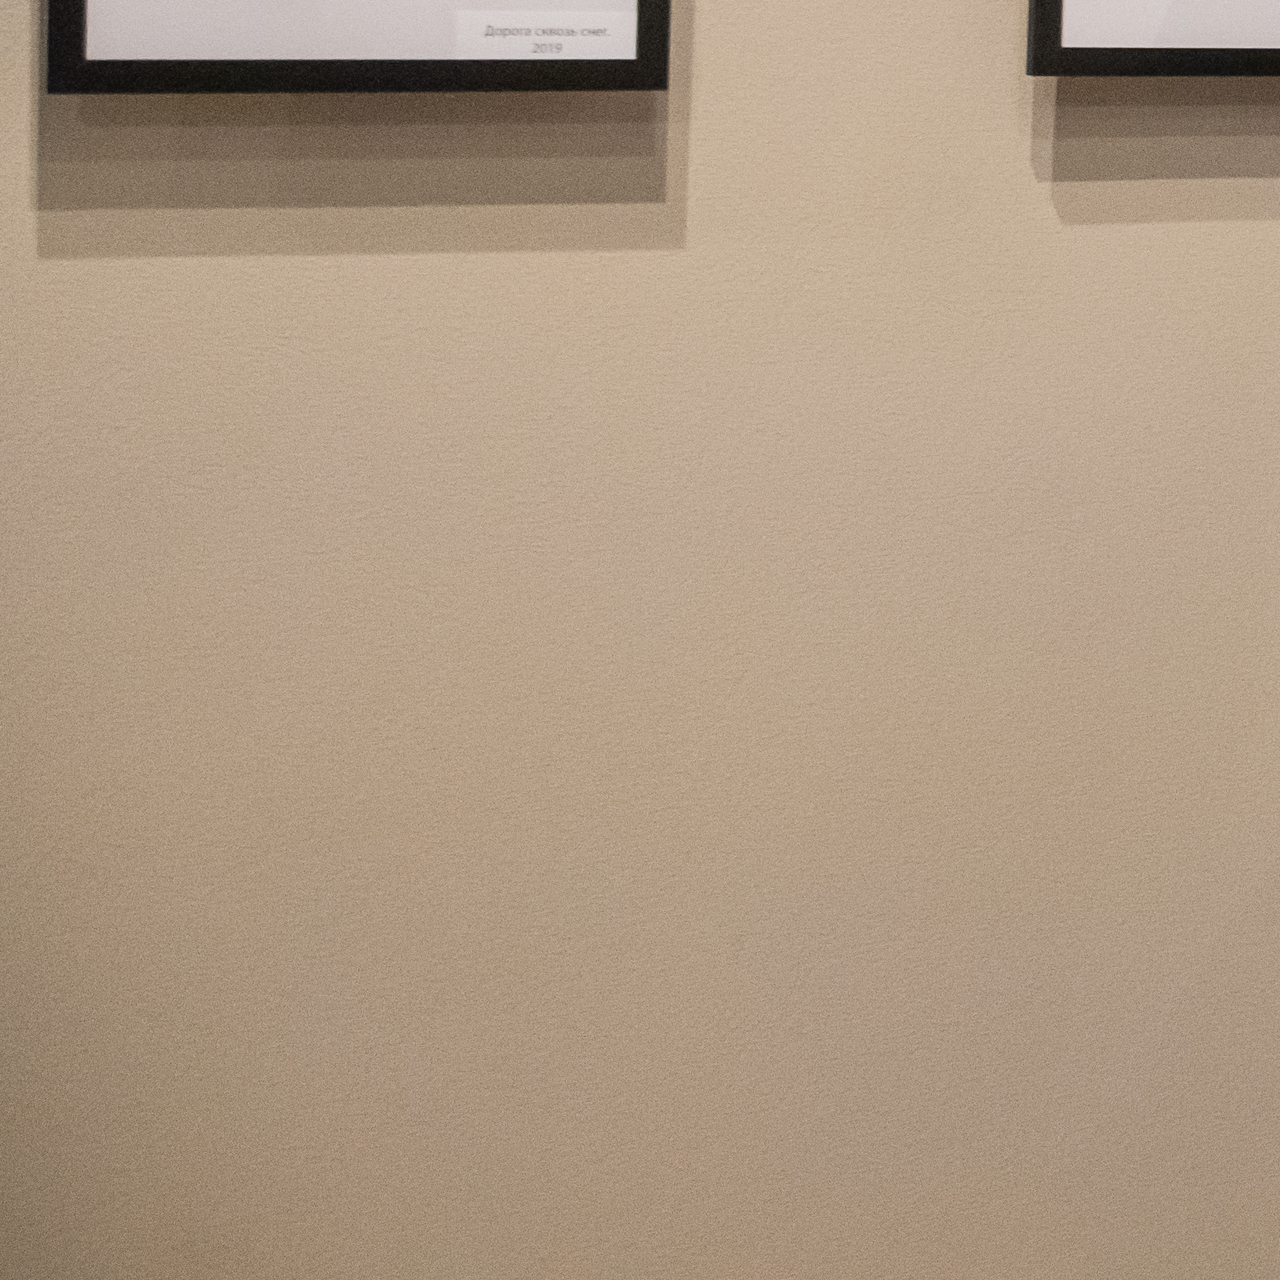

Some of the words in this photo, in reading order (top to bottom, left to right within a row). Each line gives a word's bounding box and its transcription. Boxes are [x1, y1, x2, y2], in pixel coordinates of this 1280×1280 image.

[484, 25, 531, 38] Дорога
[535, 27, 578, 37] сквозь
[532, 43, 563, 54] 2019
